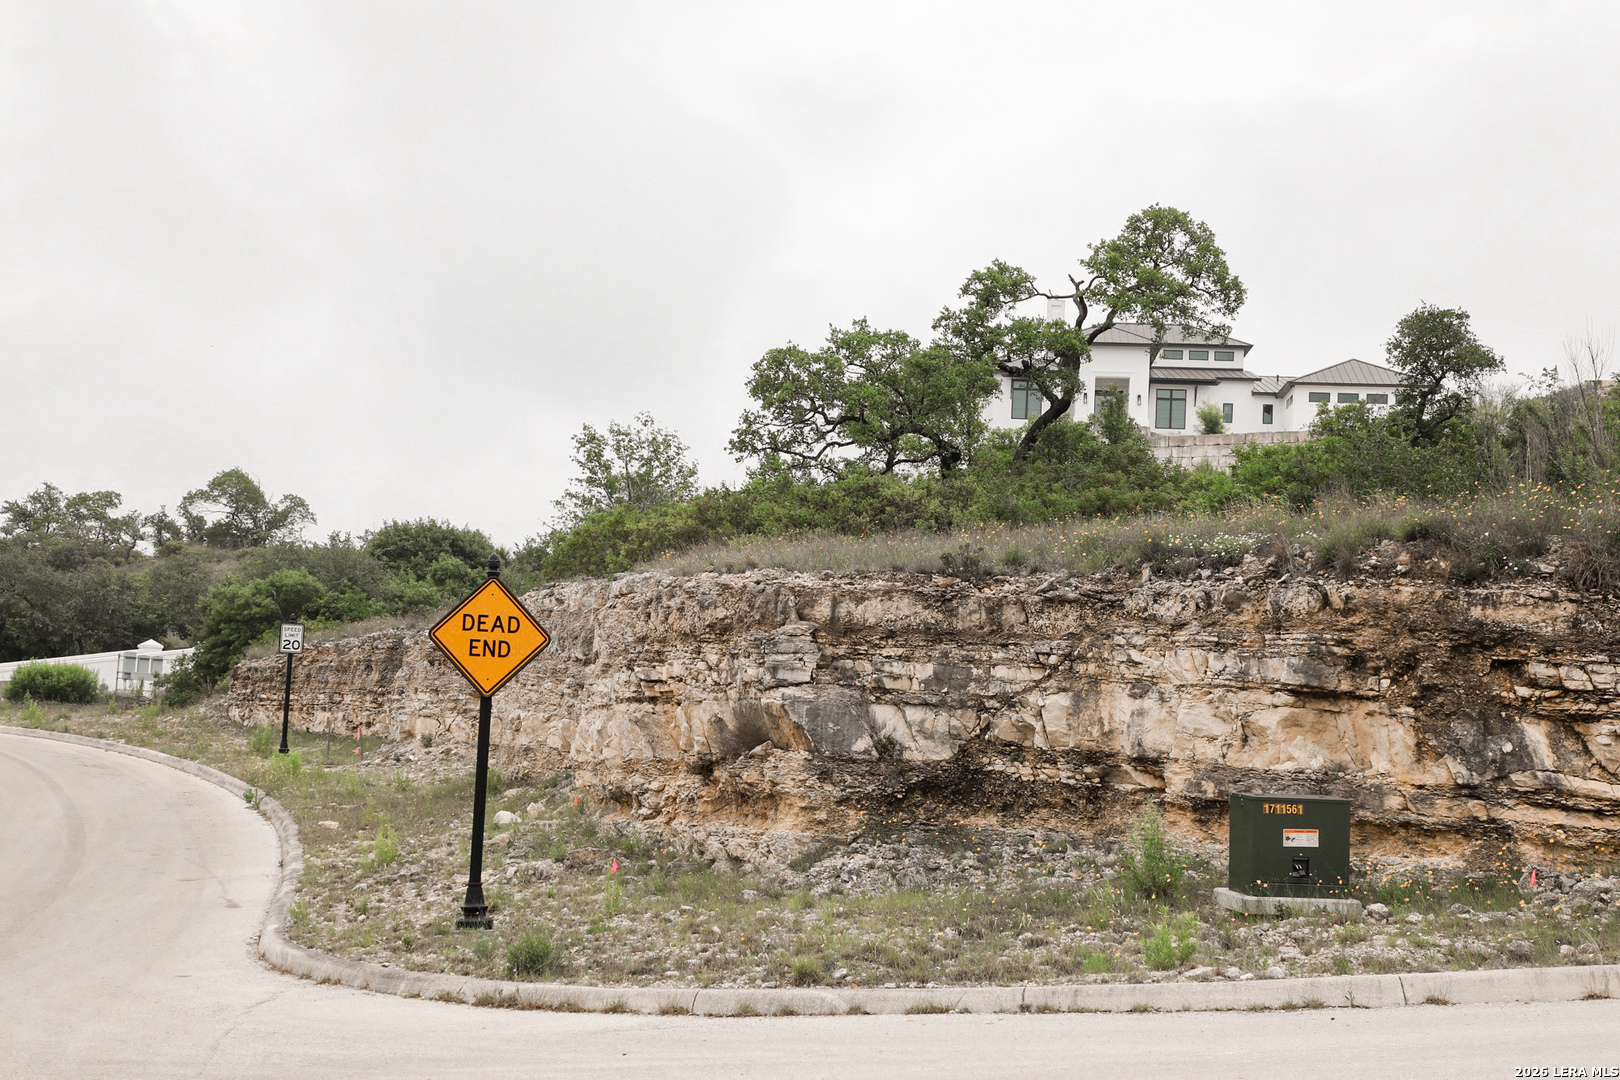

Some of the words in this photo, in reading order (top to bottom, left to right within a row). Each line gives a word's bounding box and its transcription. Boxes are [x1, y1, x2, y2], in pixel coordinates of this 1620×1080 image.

[462, 613, 521, 634] DEAD
[282, 639, 301, 650] 20
[468, 638, 511, 658] END
[1263, 803, 1303, 815] 1711561
